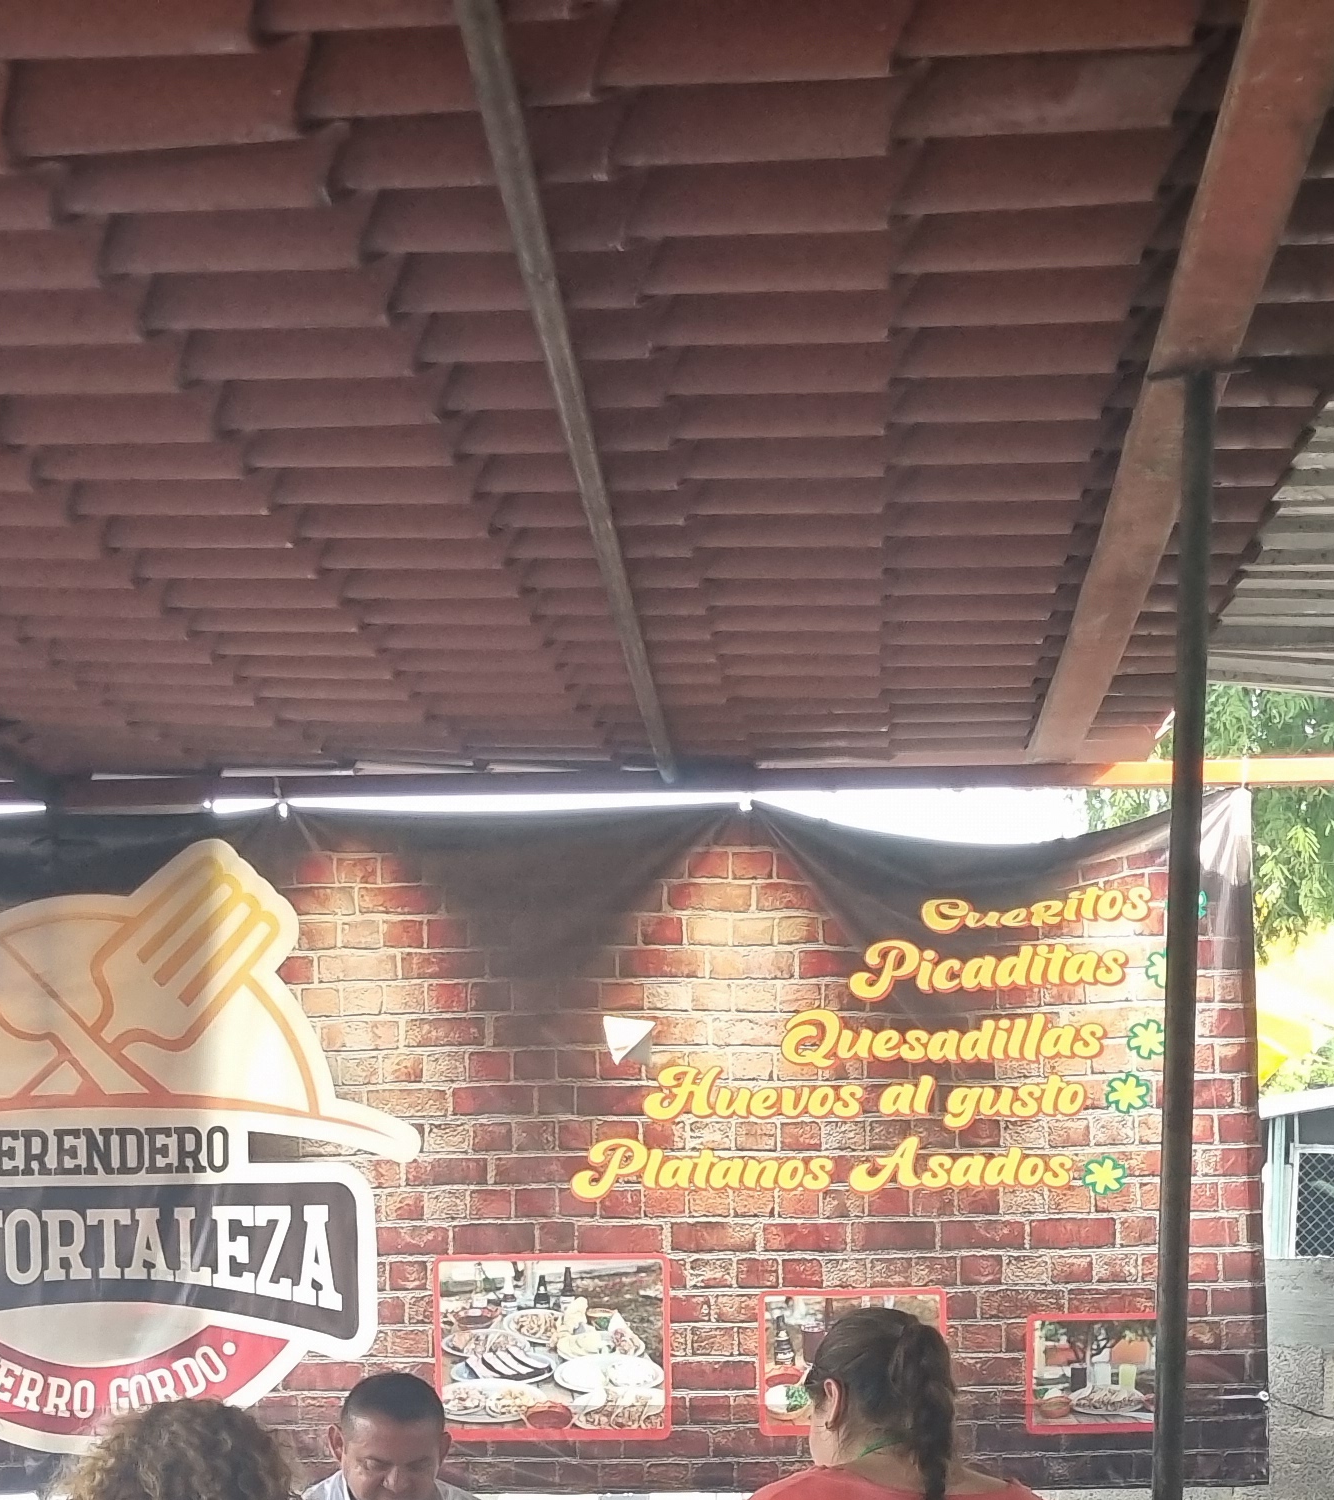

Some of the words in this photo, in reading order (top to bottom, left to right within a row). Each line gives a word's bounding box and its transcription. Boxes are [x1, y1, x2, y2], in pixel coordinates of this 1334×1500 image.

[921, 886, 1151, 933] Cueritos
[848, 940, 1128, 1001] Picaditas
[782, 1009, 1107, 1068] Quesadillas
[643, 1065, 863, 1120] Huevos
[879, 1075, 934, 1117] al
[944, 1074, 1085, 1131] gusto
[571, 1138, 832, 1202] Platanos
[850, 1136, 1073, 1193] Asados
[109, 1345, 227, 1415] GORDO
